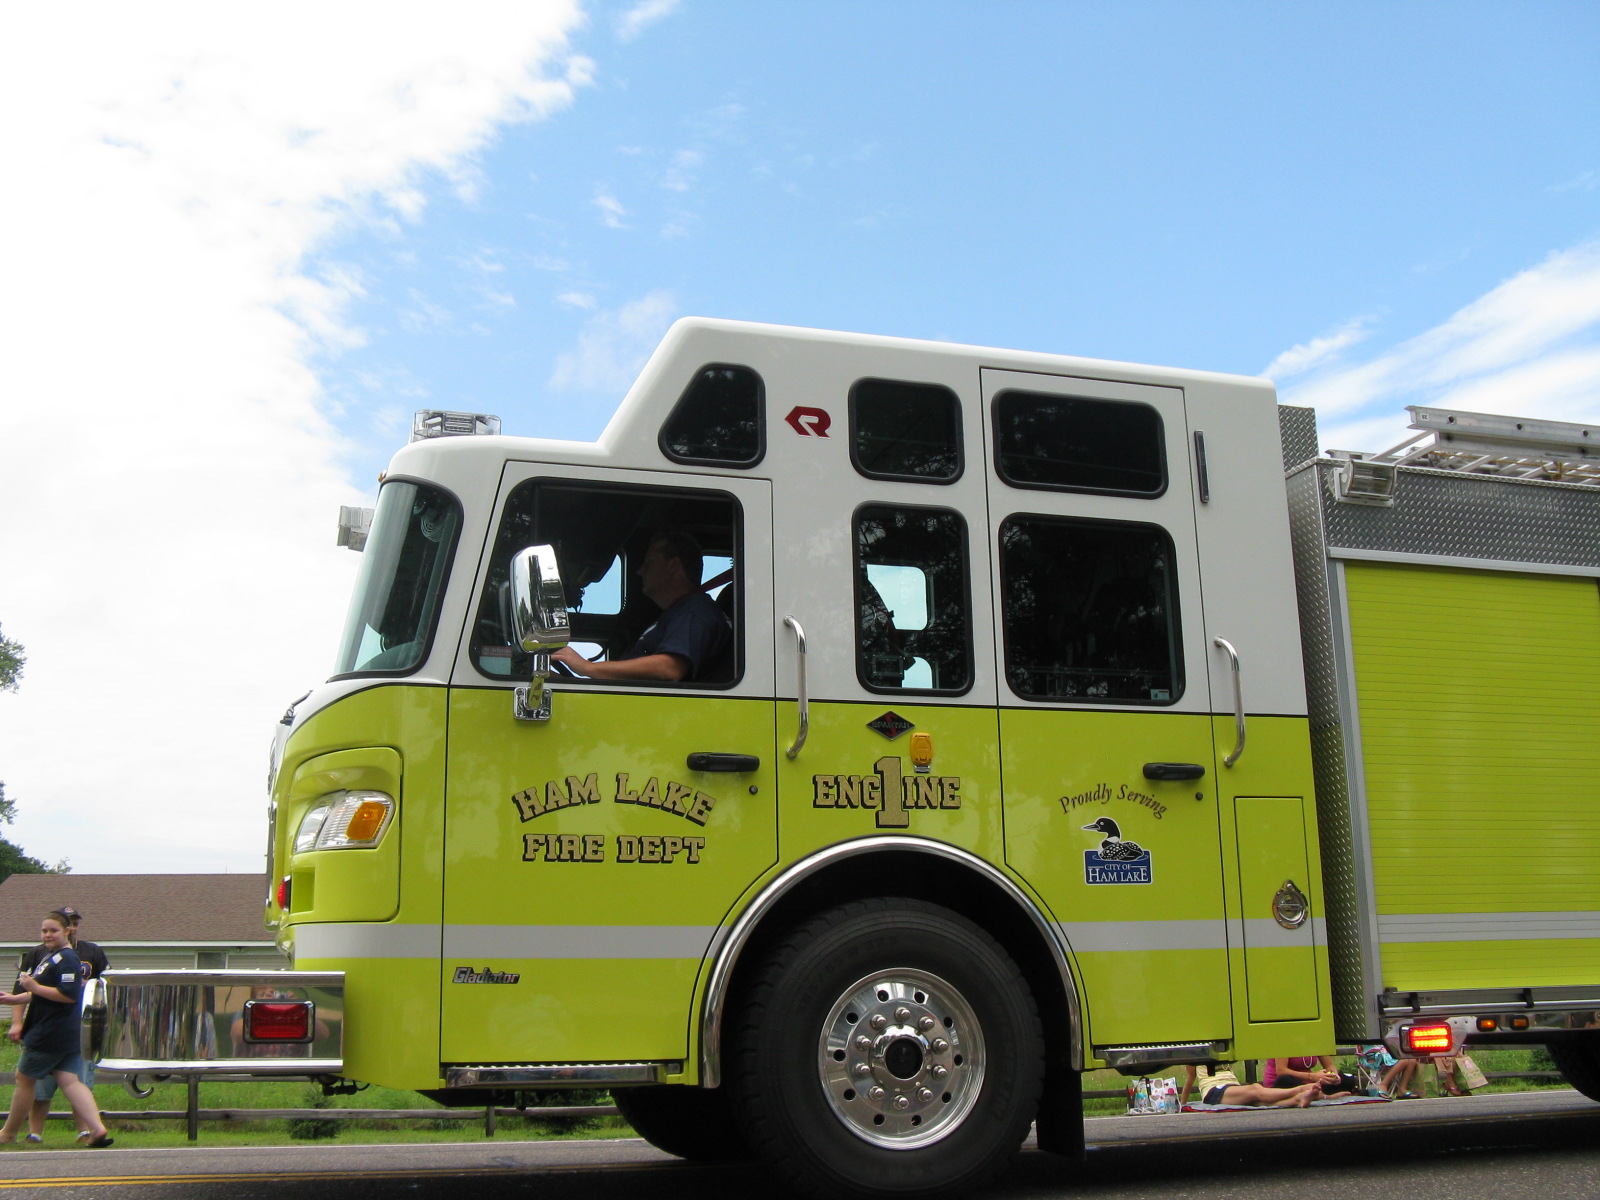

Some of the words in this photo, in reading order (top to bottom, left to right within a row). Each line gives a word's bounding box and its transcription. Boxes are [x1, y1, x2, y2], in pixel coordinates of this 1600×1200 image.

[871, 721, 911, 729] SPARTAN
[511, 772, 601, 823] HAM
[614, 772, 716, 827] LAKE
[1058, 783, 1112, 814] Proudly
[1117, 784, 1167, 819] Serving
[522, 834, 604, 862] FIRE
[616, 835, 705, 864] DEPT
[1088, 868, 1119, 882] HAM
[1120, 868, 1149, 882] LAKE
[1104, 863, 1121, 871] CITY
[1121, 863, 1131, 871] OF
